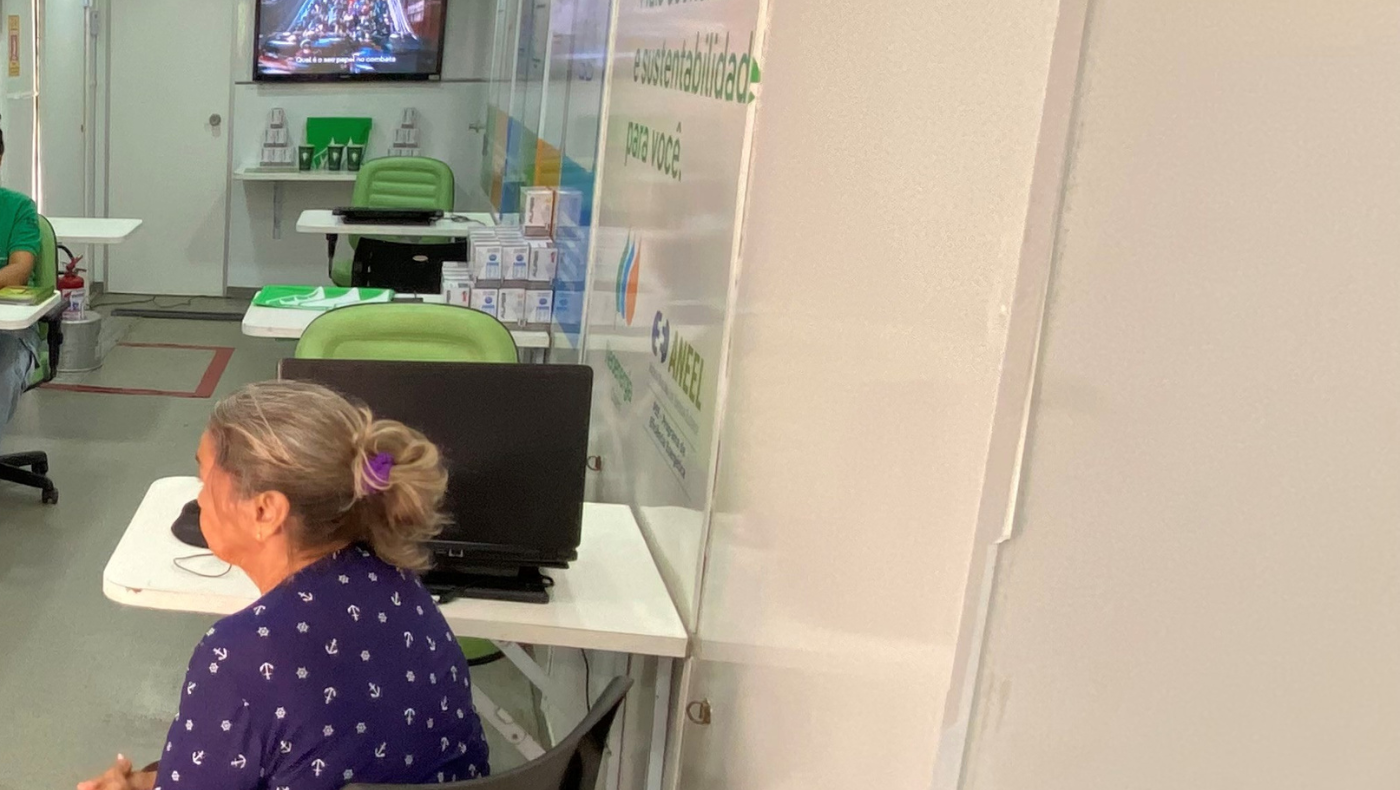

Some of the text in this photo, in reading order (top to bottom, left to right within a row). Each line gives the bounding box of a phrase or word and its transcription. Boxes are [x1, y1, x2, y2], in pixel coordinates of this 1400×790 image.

[634, 48, 641, 83] e
[624, 121, 649, 166] para
[668, 330, 704, 411] ANEEL
